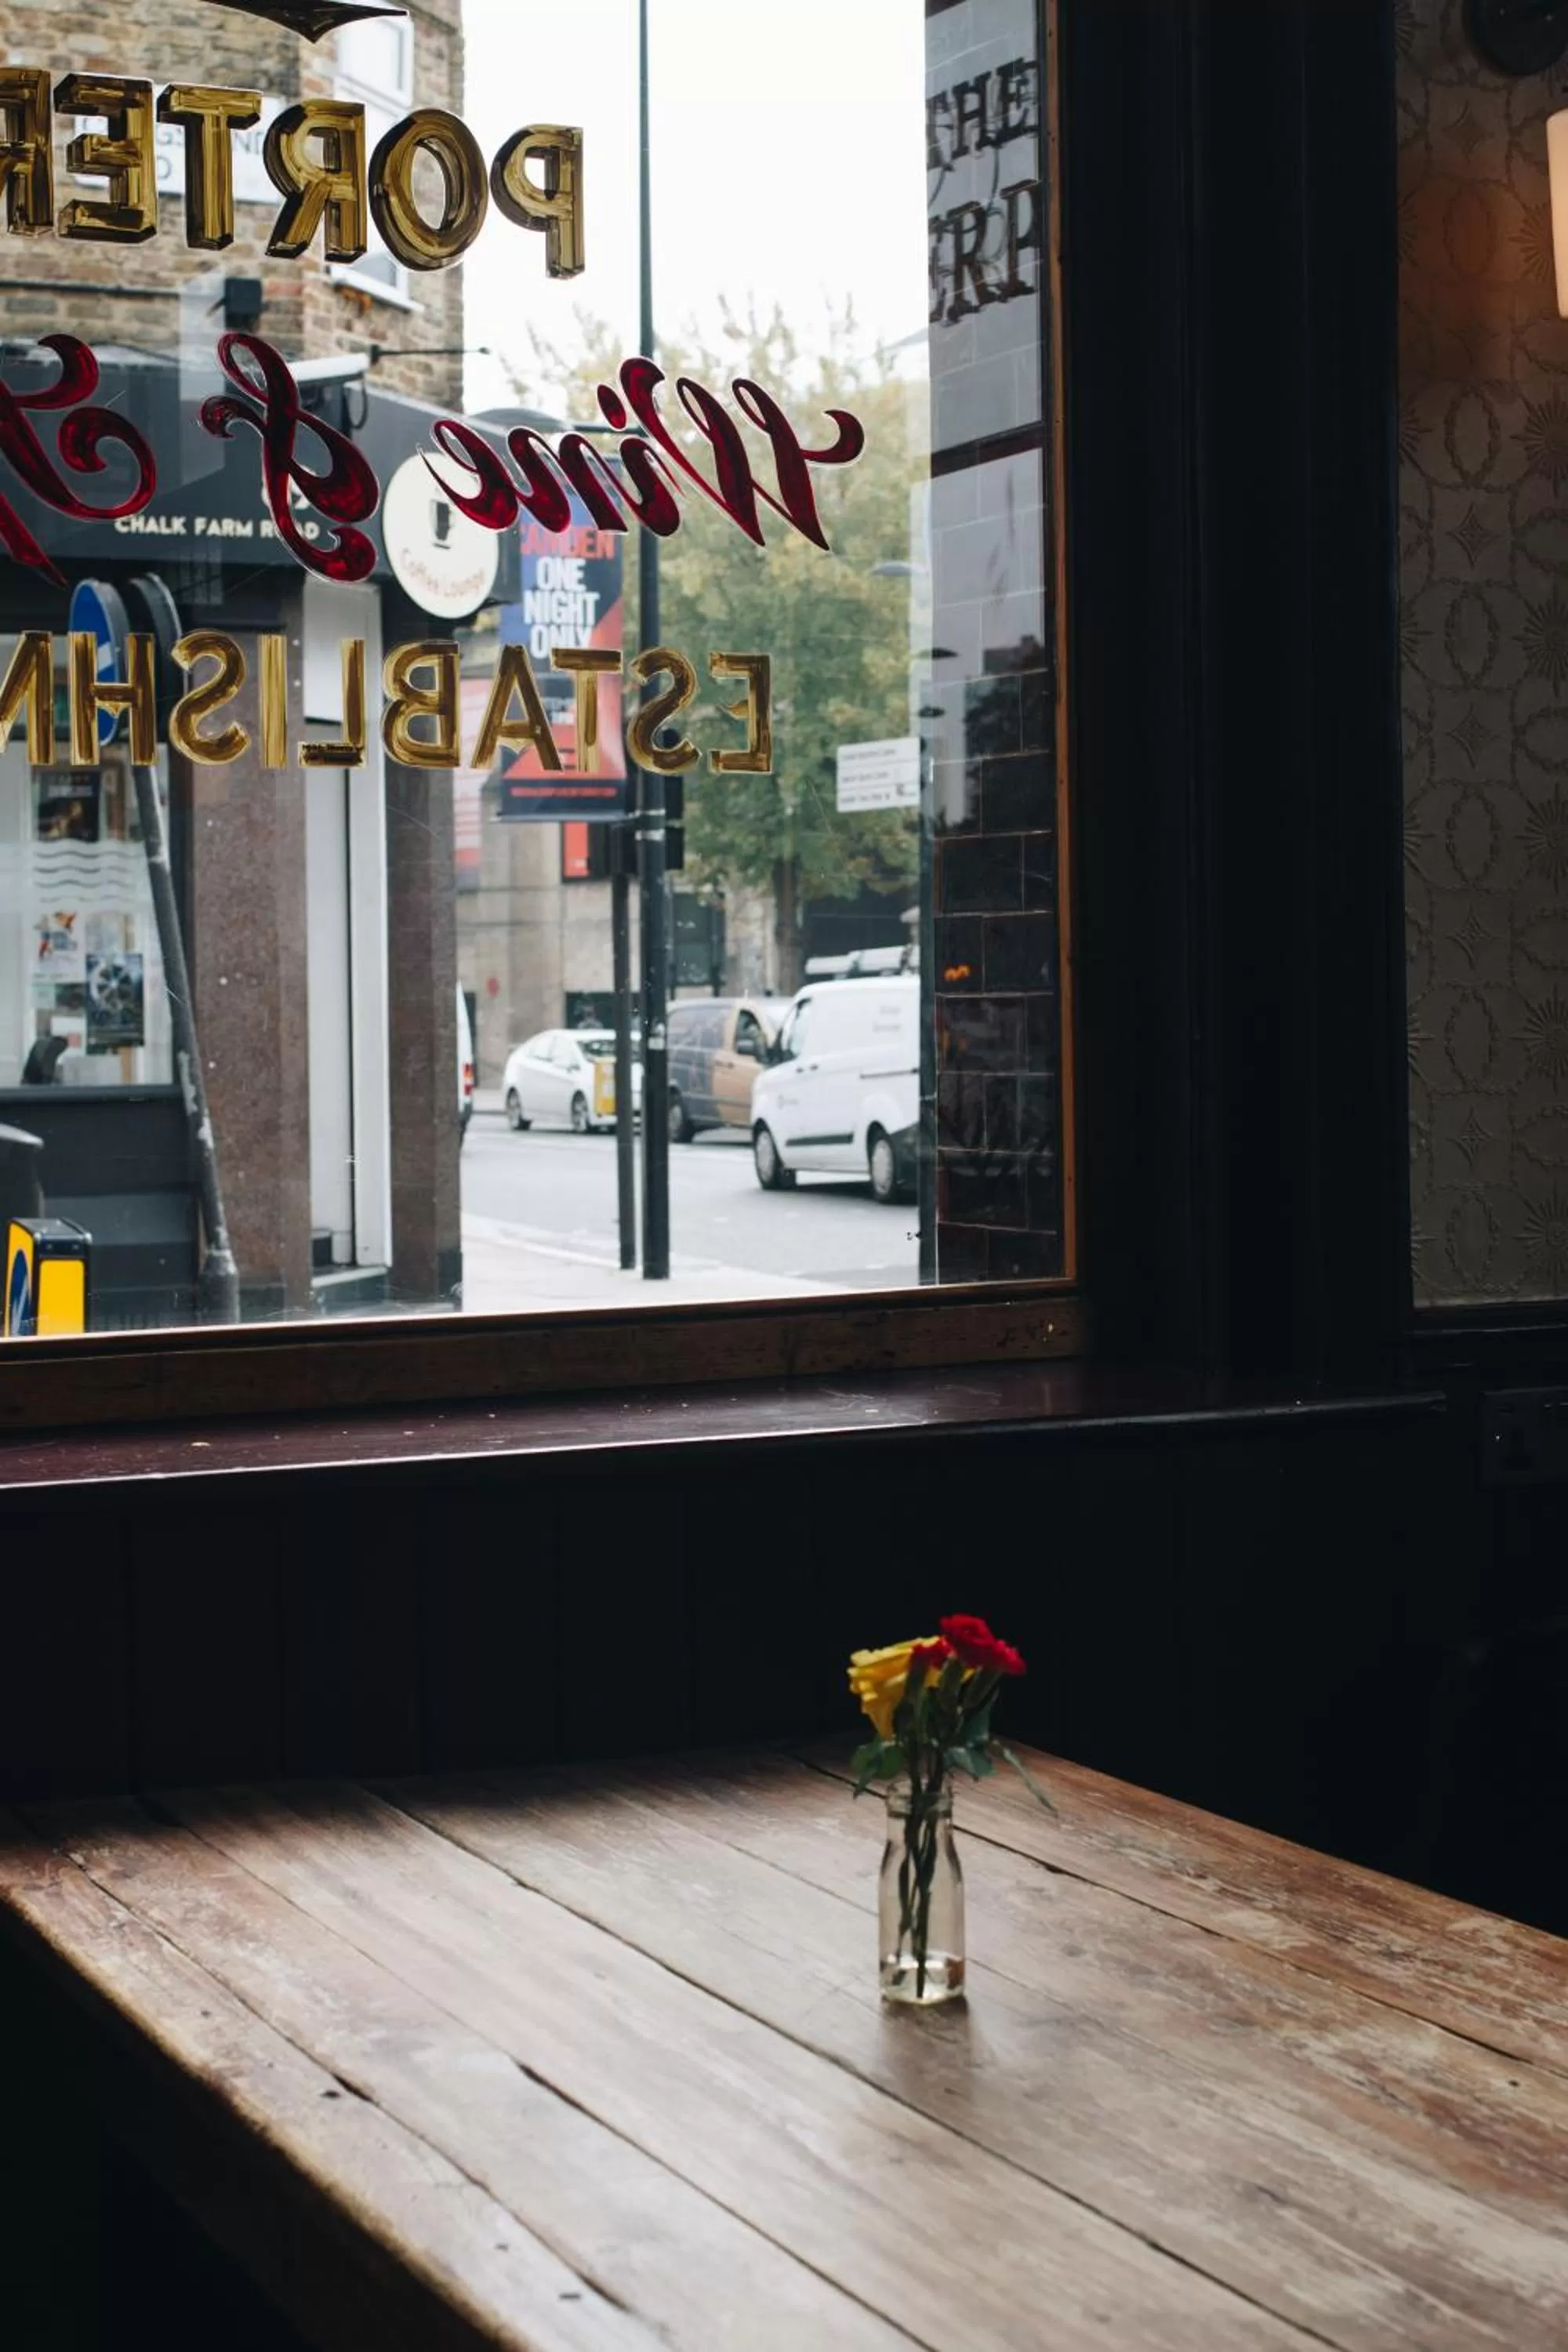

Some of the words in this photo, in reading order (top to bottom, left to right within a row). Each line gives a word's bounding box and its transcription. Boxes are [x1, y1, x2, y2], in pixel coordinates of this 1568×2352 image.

[114, 514, 187, 535] CHALK
[194, 517, 254, 538] FARM
[260, 520, 321, 541] RD
[520, 524, 615, 560] AMDEN
[536, 556, 587, 591] ONE
[523, 590, 601, 626] NIGHT
